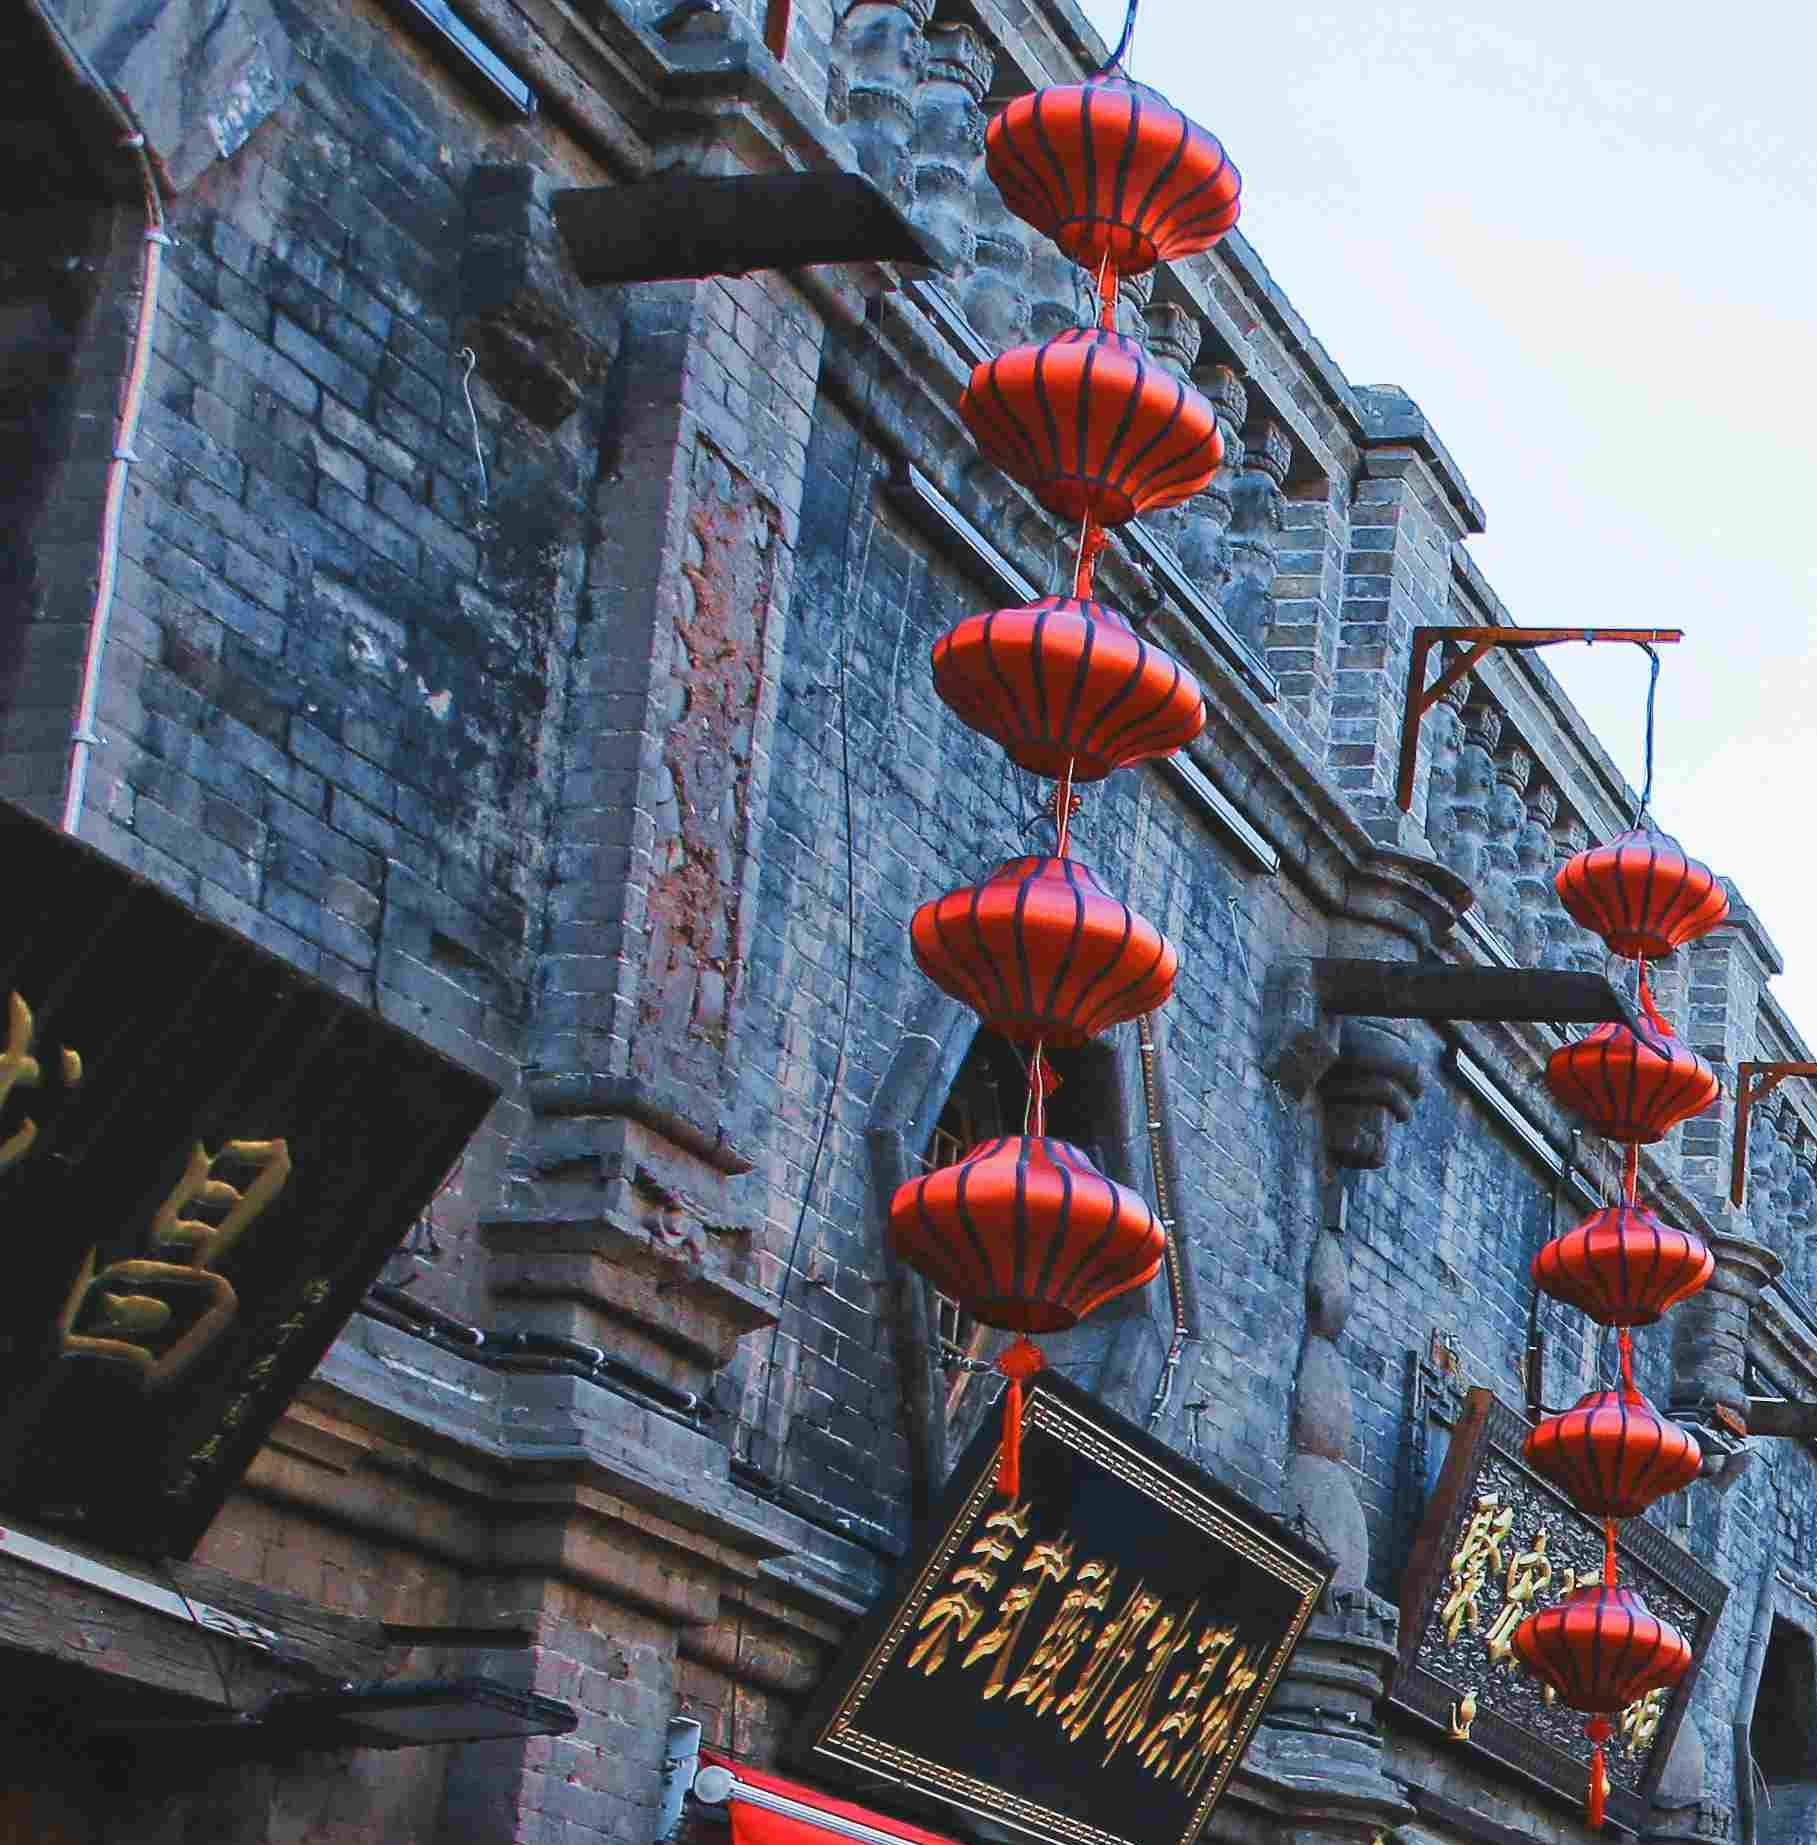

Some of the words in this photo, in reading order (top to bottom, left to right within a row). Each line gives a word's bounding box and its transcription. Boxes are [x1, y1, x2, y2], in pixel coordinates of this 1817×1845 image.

[906, 1498, 1271, 1799] 美式酸奶冰淇淋
